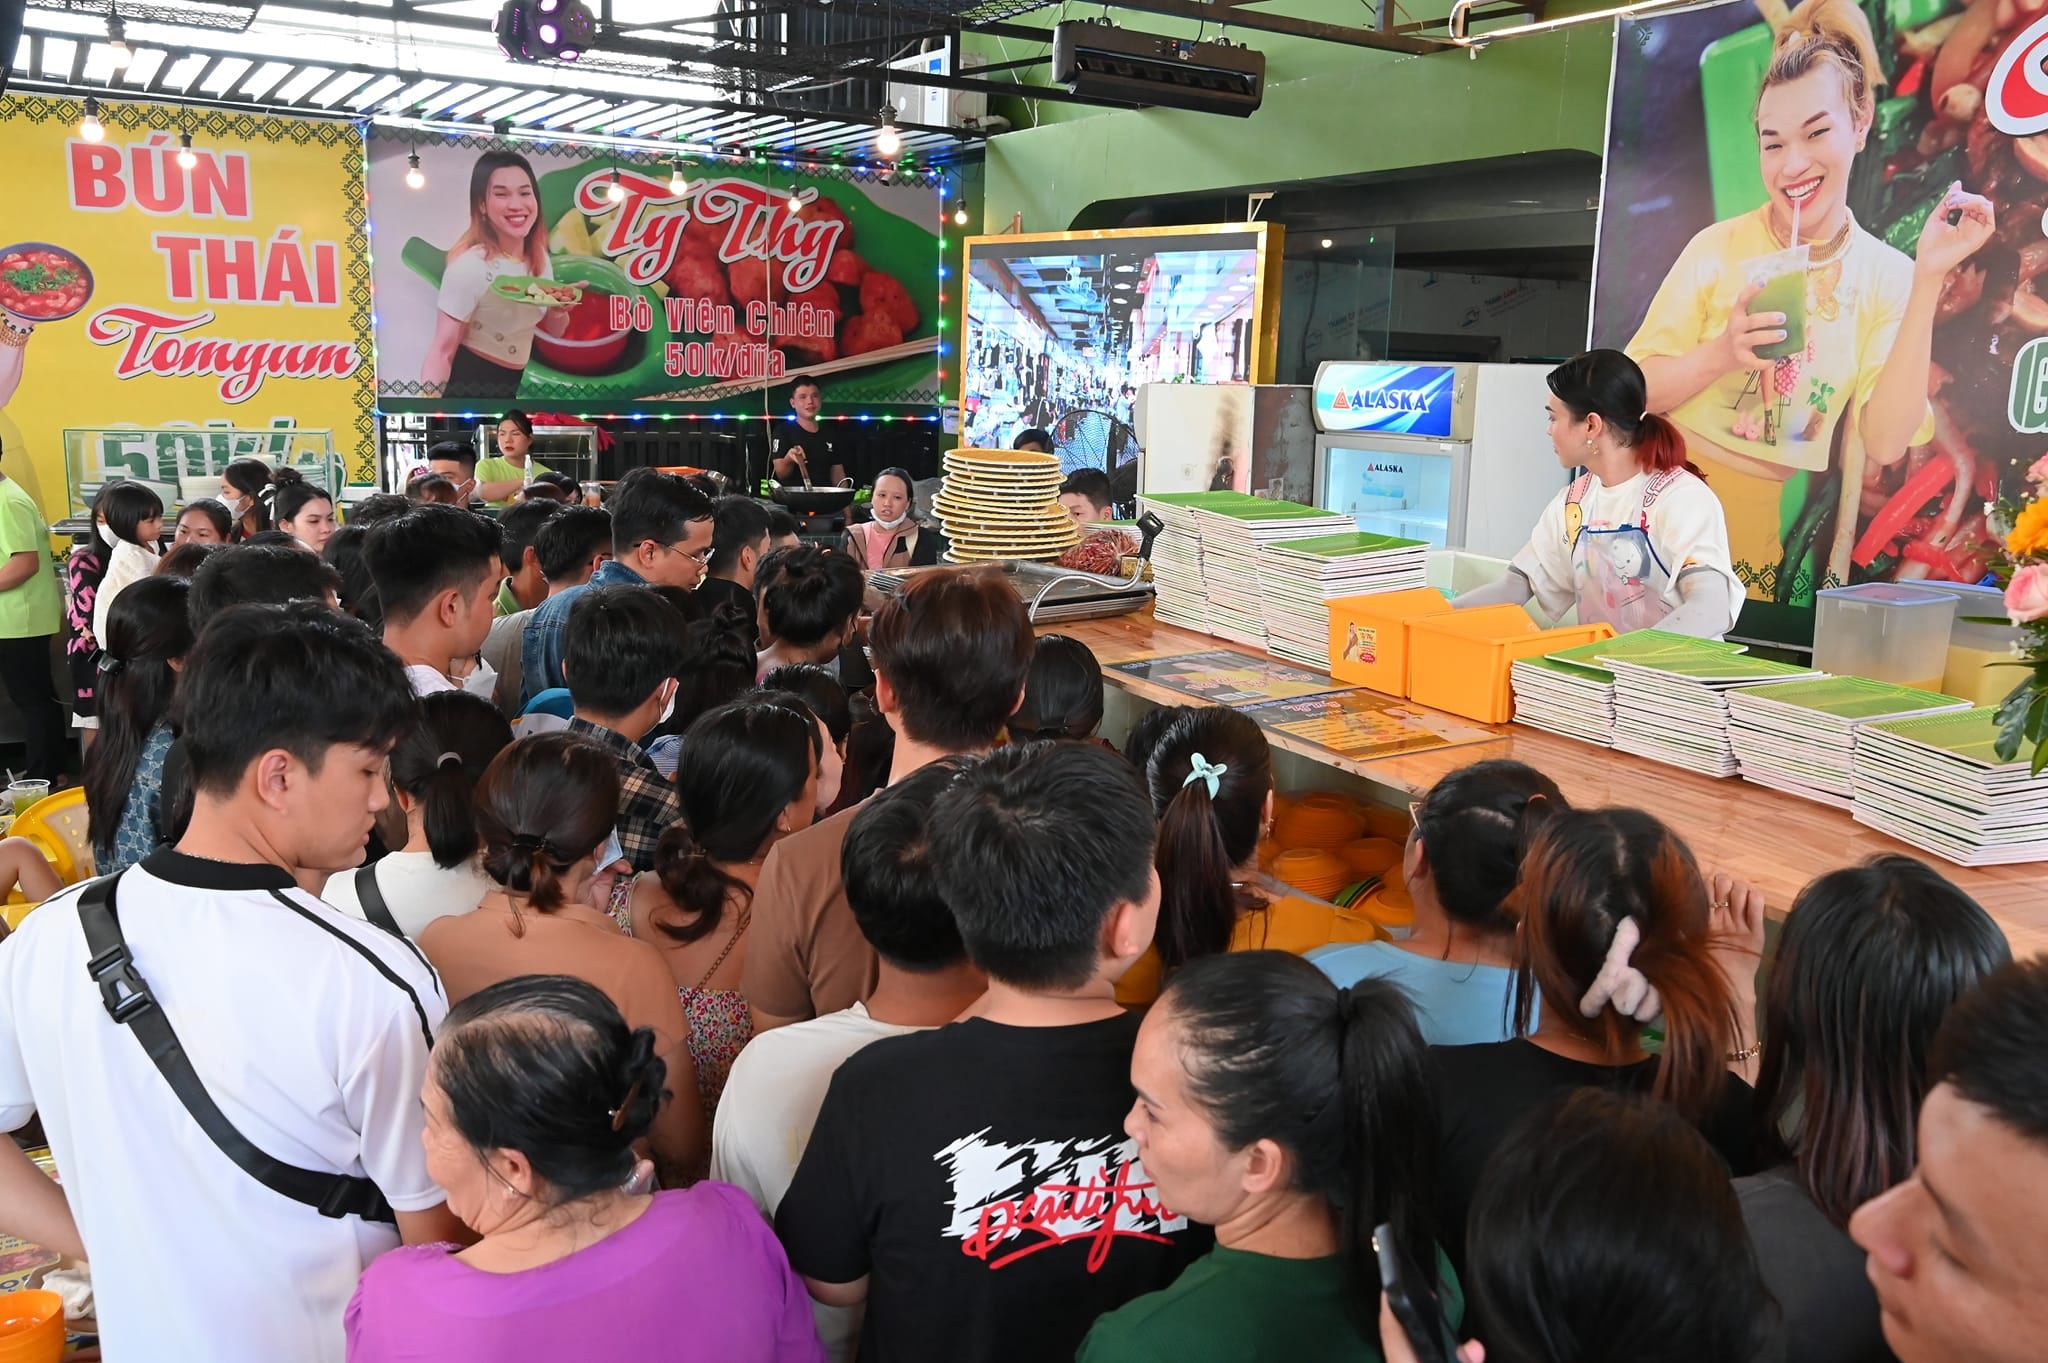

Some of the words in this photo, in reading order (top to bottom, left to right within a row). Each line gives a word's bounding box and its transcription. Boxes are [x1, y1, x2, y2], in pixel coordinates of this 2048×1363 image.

[68, 133, 250, 219] BÚN
[155, 228, 339, 305] THÁI
[609, 295, 653, 332] Bò
[664, 297, 735, 334] Viên
[746, 300, 834, 338] Chiên
[87, 307, 359, 401] Tomyum
[1352, 389, 1429, 412] ALASKA
[1374, 463, 1404, 473] ALASKA
